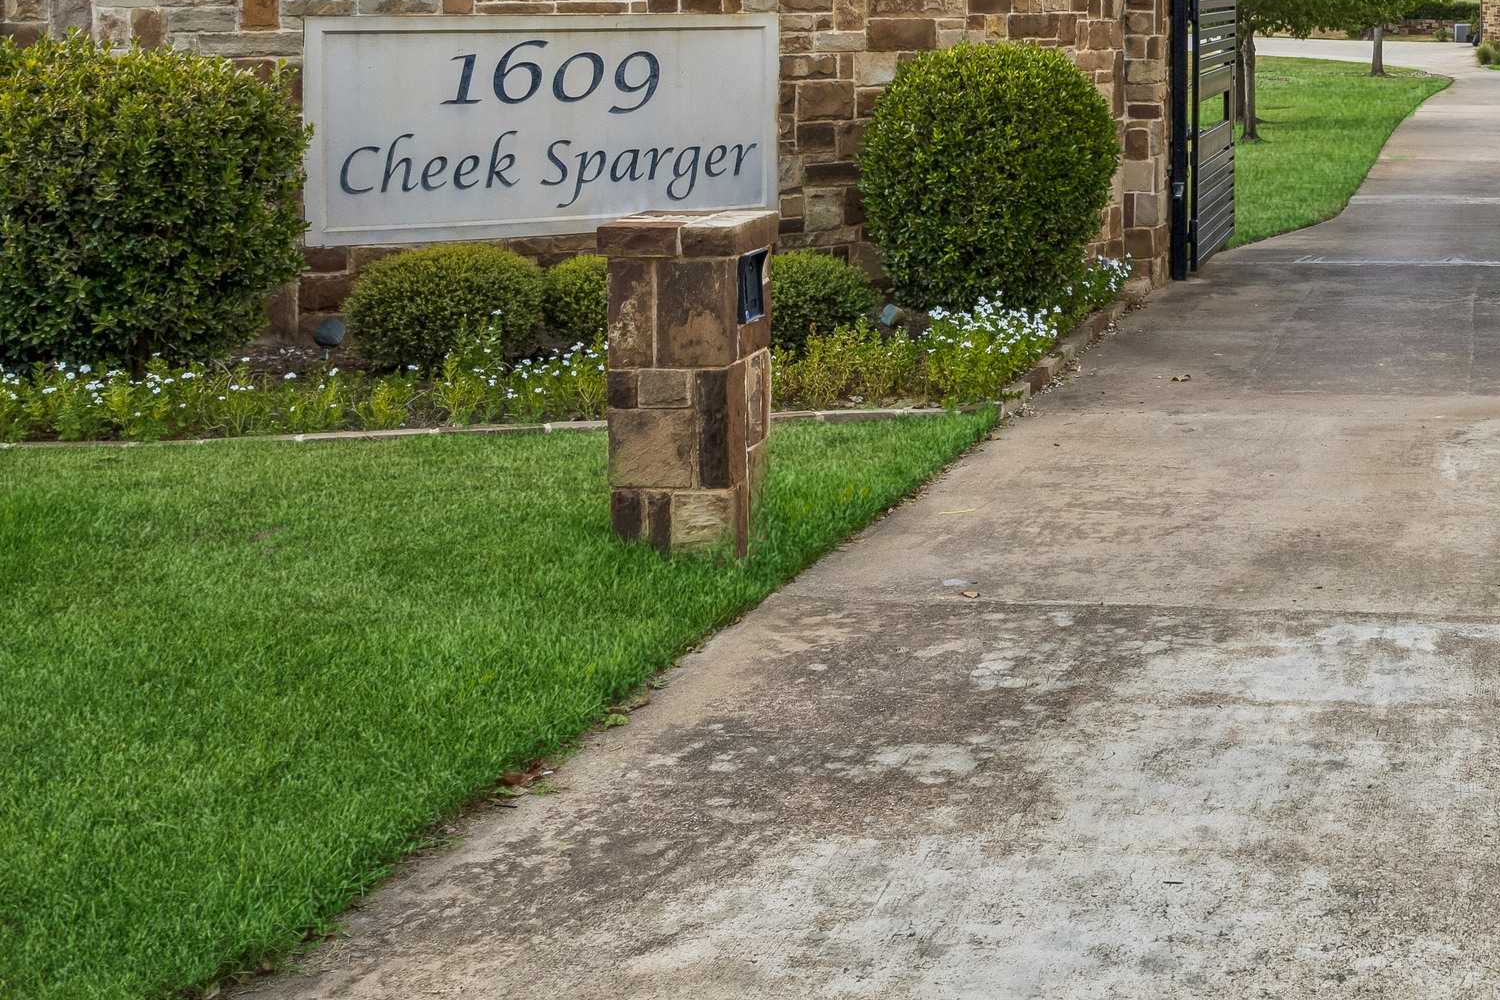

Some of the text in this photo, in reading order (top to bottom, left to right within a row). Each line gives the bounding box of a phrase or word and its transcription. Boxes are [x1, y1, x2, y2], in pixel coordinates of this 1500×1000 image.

[440, 39, 660, 115] 1609
[339, 130, 758, 209] Cheek Sparger
